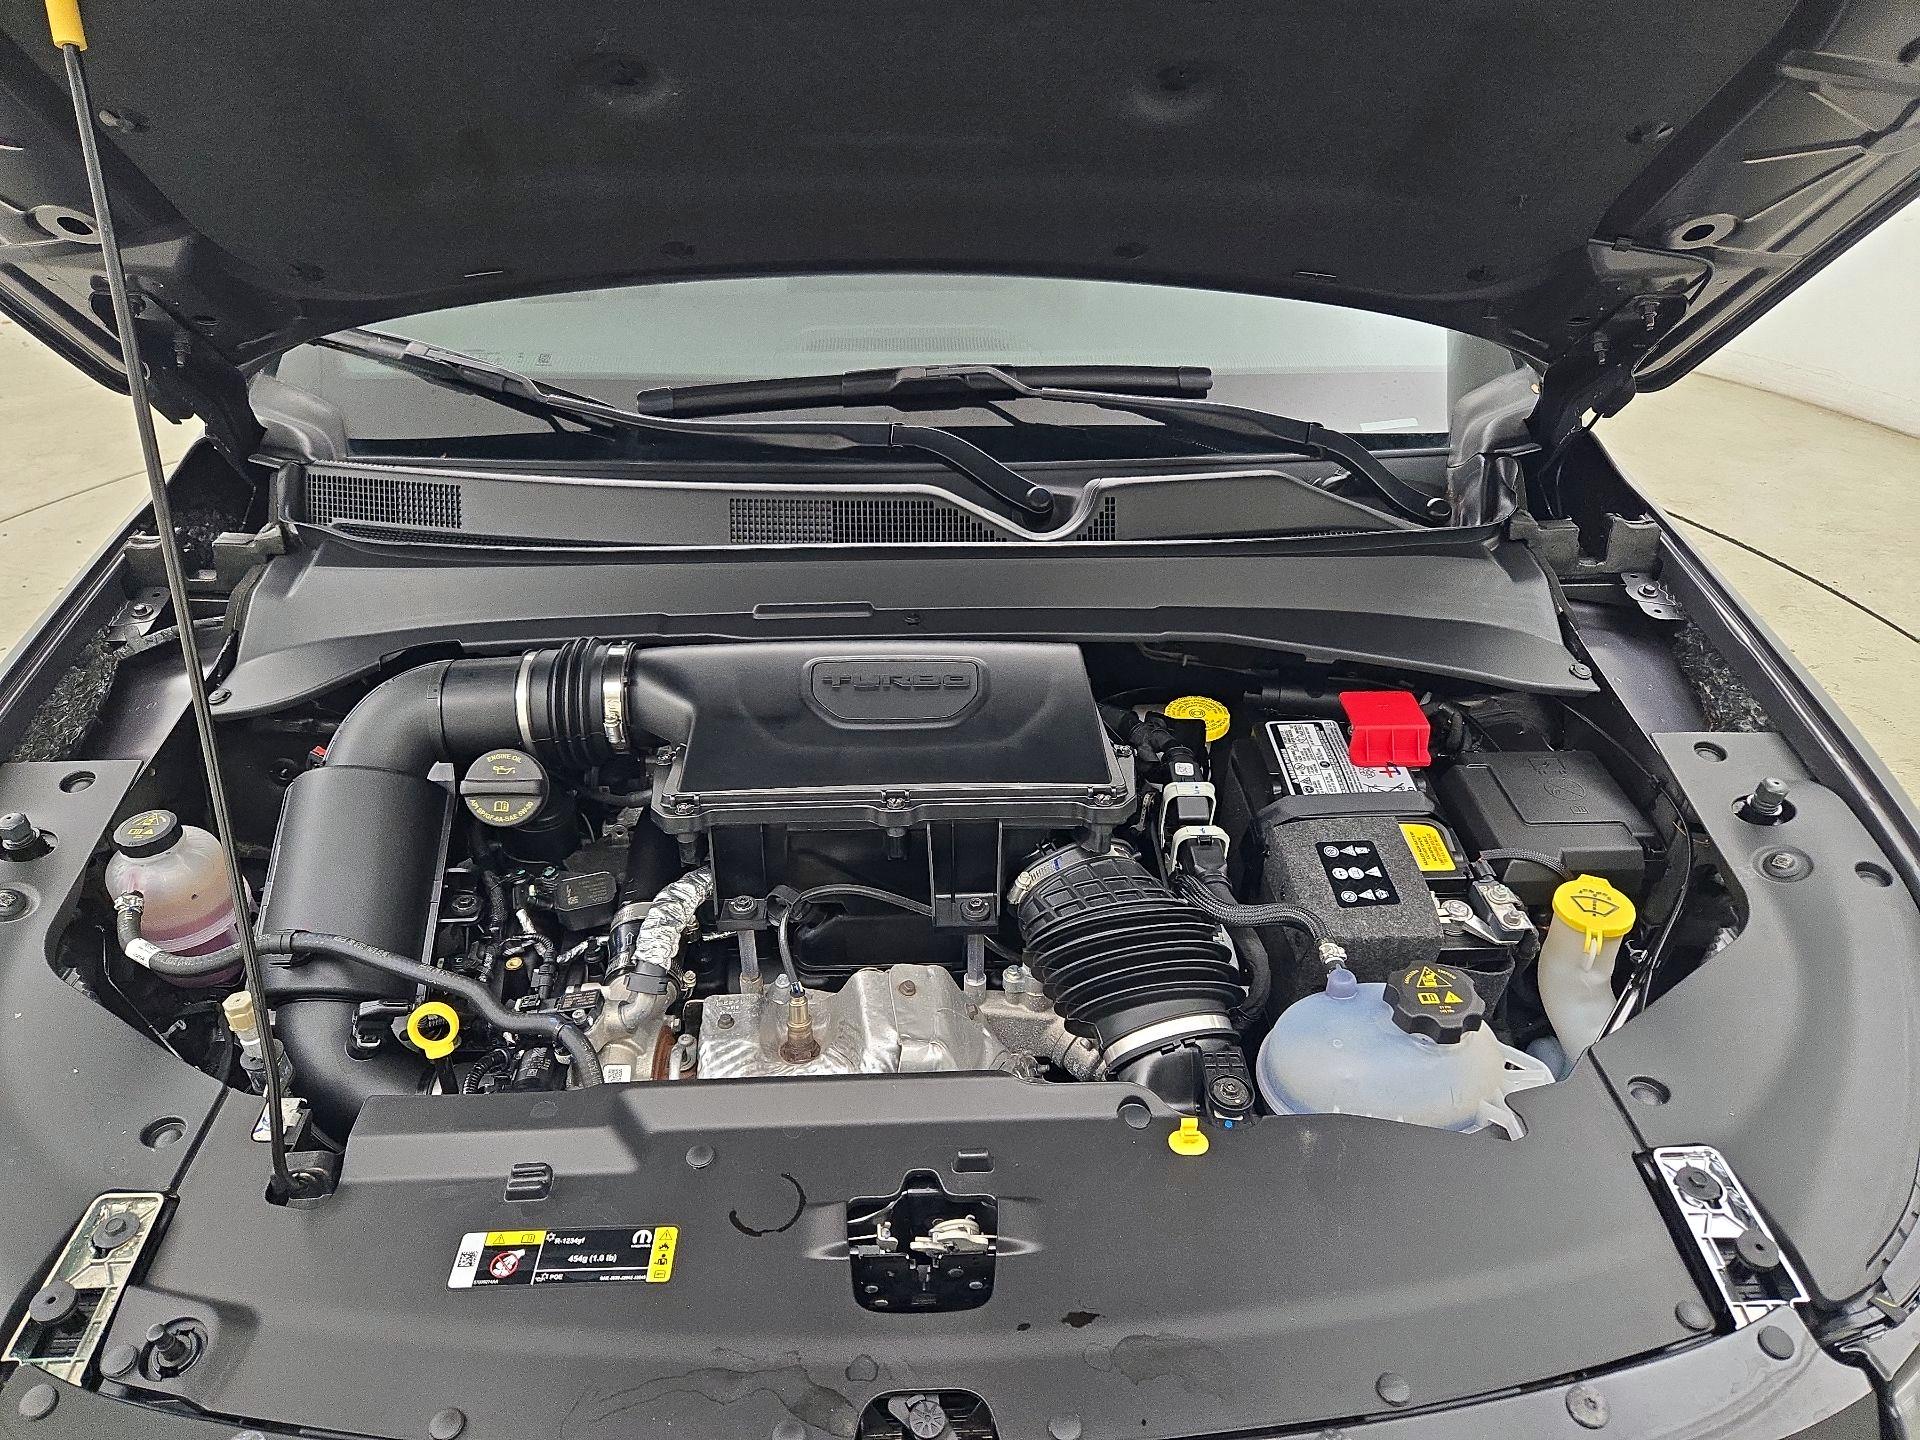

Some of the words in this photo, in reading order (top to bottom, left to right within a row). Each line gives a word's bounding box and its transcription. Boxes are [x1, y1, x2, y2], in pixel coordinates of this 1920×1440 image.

[821, 674, 971, 690] TURBO
[486, 753, 511, 763] ENGINE
[512, 754, 522, 763] OIL
[469, 799, 479, 810] API
[554, 1236, 585, 1246] R-1234yf
[567, 1254, 588, 1264] 454g
[588, 1254, 604, 1264] (1.0
[605, 1253, 618, 1263] lb)
[549, 1273, 564, 1281] POE
